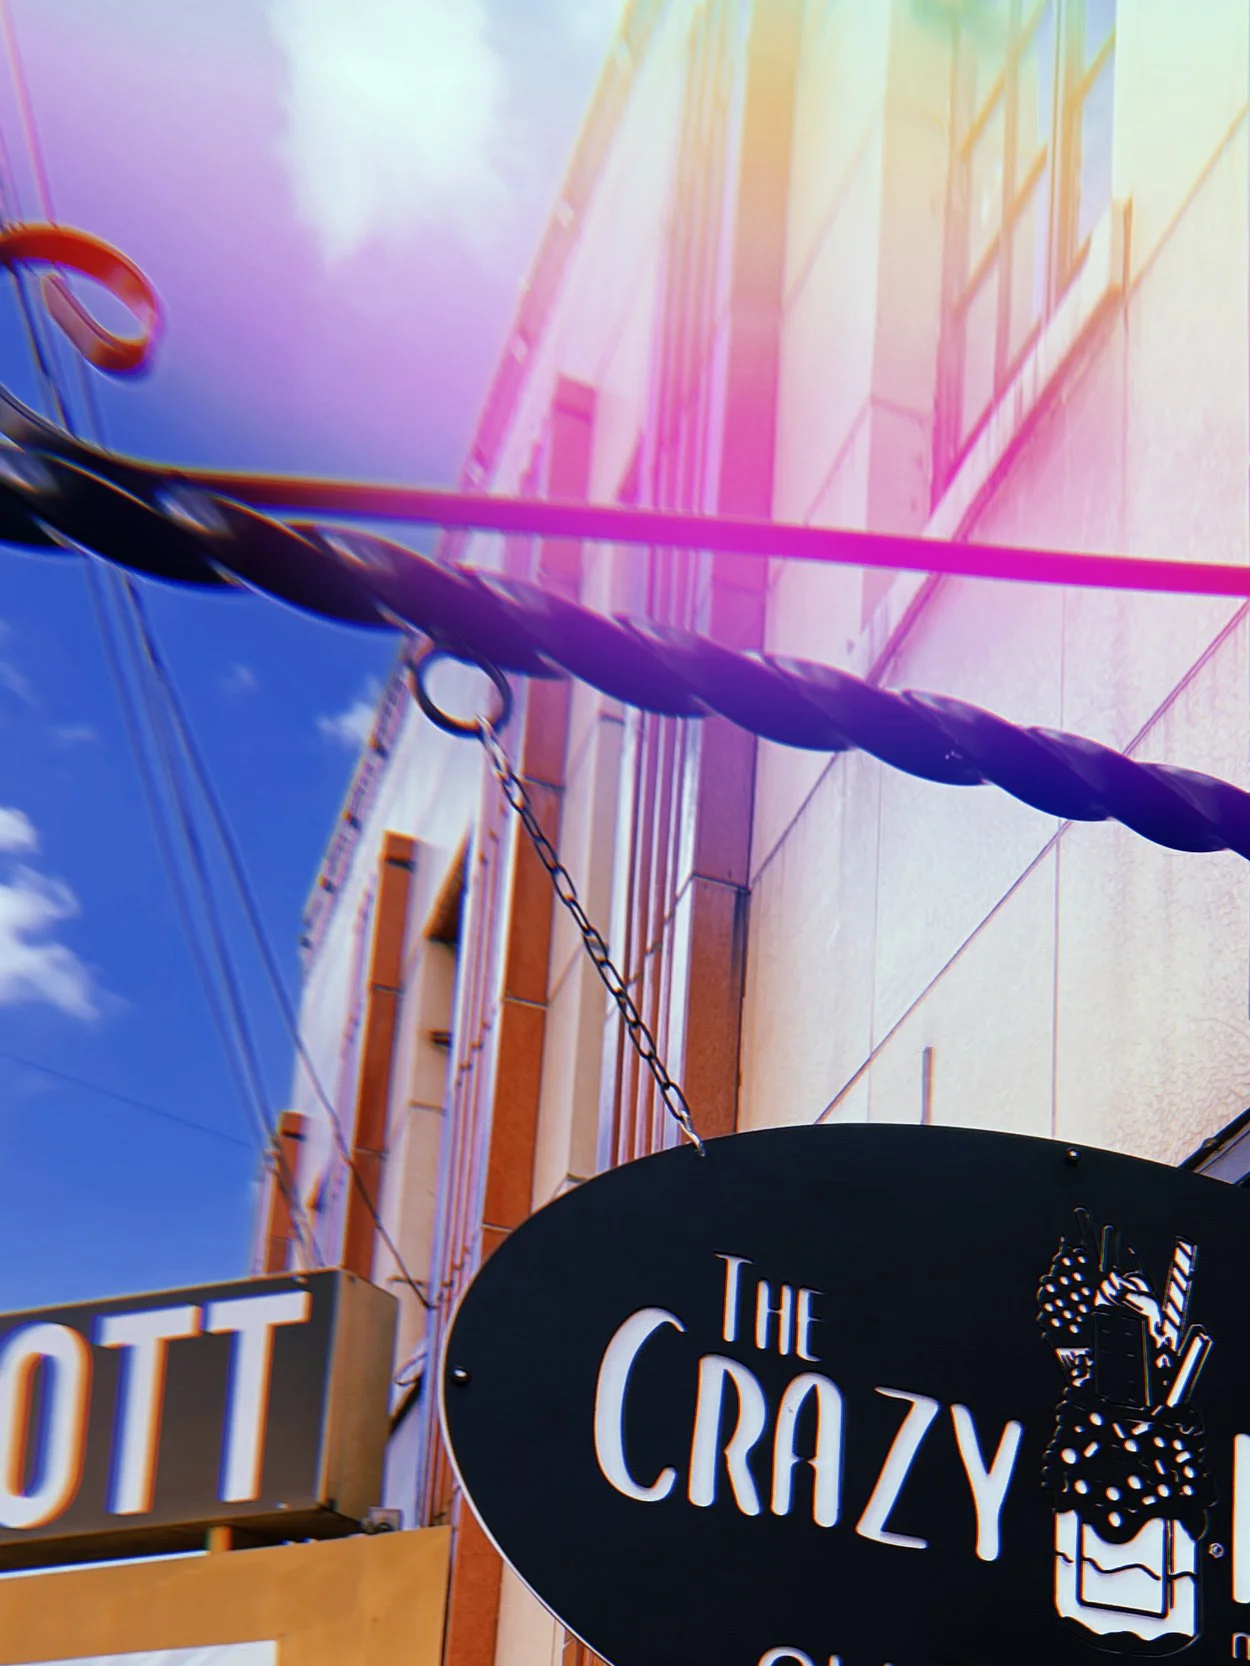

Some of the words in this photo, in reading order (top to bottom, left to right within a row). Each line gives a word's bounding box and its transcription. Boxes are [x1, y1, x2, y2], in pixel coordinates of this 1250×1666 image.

[0, 1288, 312, 1530] OTT
[714, 1250, 826, 1362] THE
[594, 1306, 1024, 1562] CRAZY
